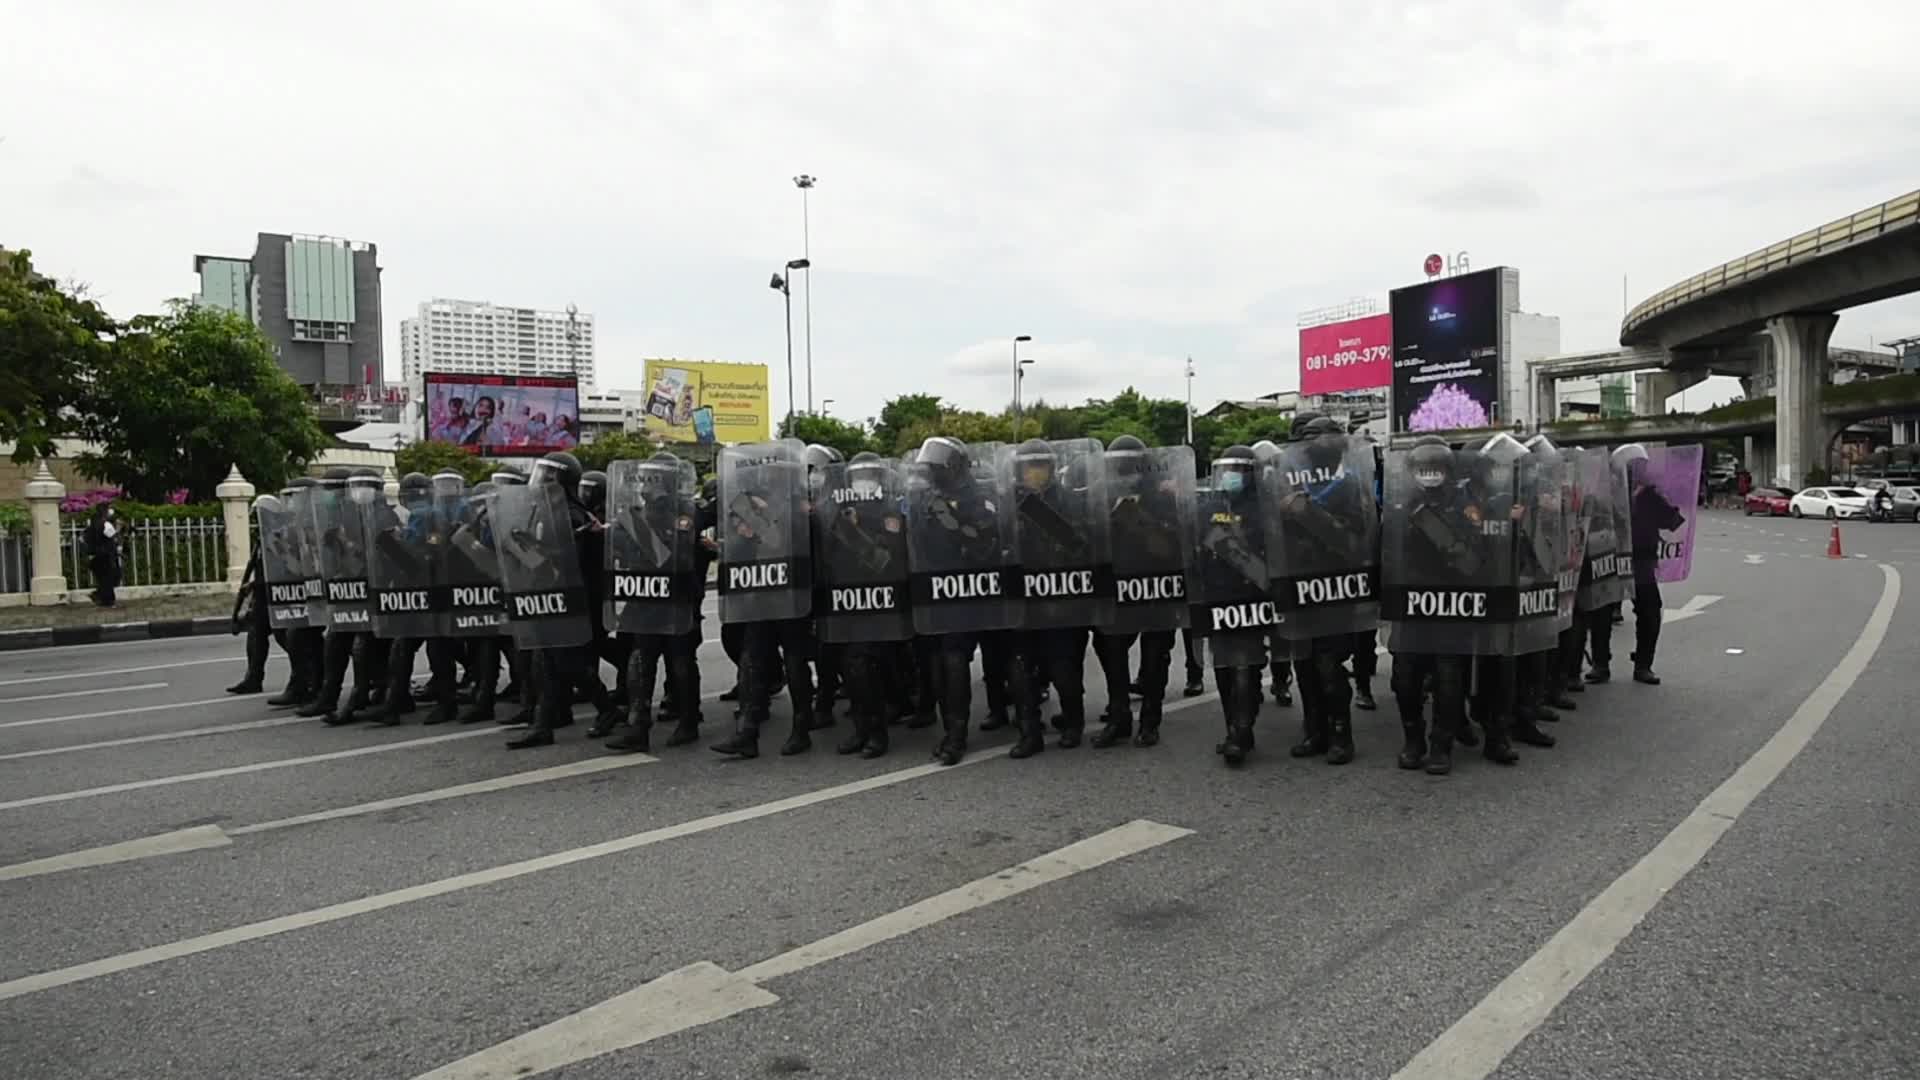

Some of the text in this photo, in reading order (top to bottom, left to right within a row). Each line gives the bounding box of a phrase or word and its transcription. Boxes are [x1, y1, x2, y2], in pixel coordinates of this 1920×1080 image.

[1447, 251, 1470, 271] LG
[614, 575, 670, 598] POLICE
[728, 562, 788, 589] POLICE
[931, 572, 1000, 600] POLICE
[1024, 570, 1094, 597] POLICE
[1116, 575, 1184, 602] POLICE
[271, 583, 306, 602] POLIC
[328, 581, 367, 600] POLICE
[379, 591, 429, 612] POLICE
[453, 586, 501, 606] POLIC
[831, 586, 895, 612] POLICE
[1295, 573, 1371, 605] POLICE
[1519, 588, 1556, 616] POLICE
[515, 593, 567, 616] POLICE
[1407, 591, 1487, 617] POLICE
